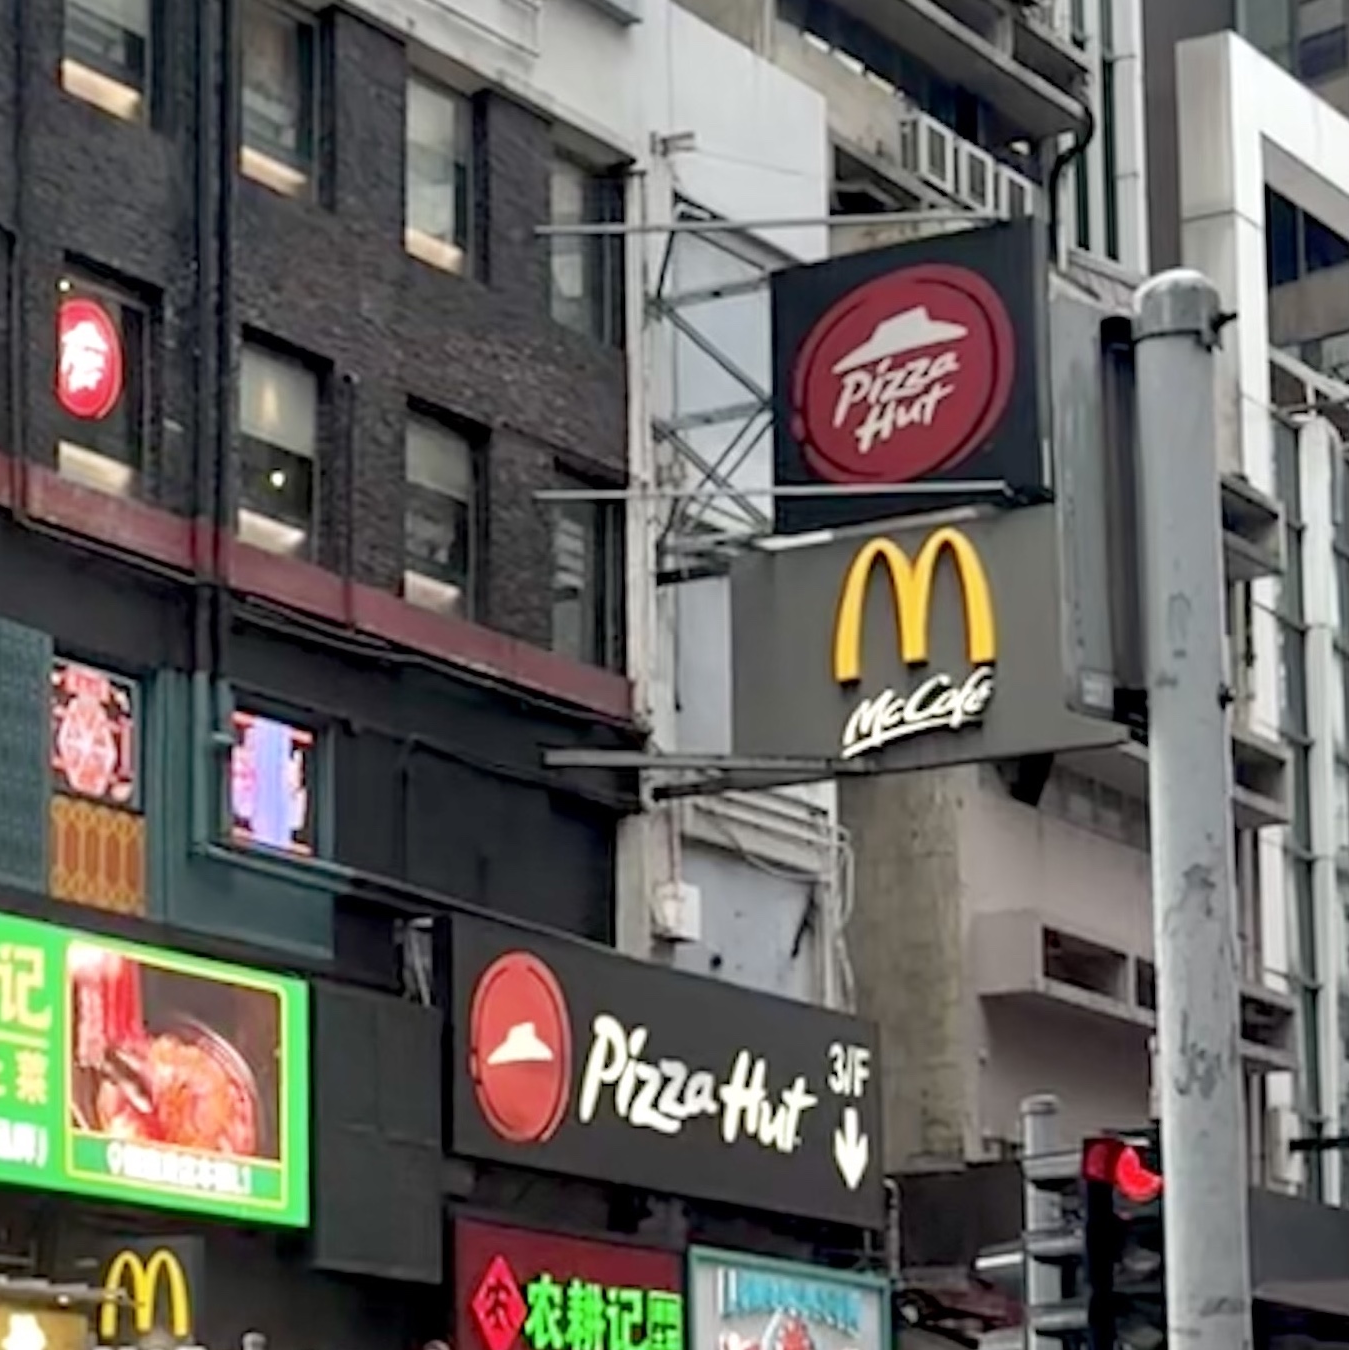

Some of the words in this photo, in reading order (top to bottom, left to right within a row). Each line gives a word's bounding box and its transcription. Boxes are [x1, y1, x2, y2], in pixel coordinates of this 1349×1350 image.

[835, 350, 959, 428] Pizza
[856, 384, 954, 453] Hut
[578, 1013, 717, 1136] Pizza
[719, 1047, 819, 1153] Hut
[827, 1041, 872, 1098] 3/F
